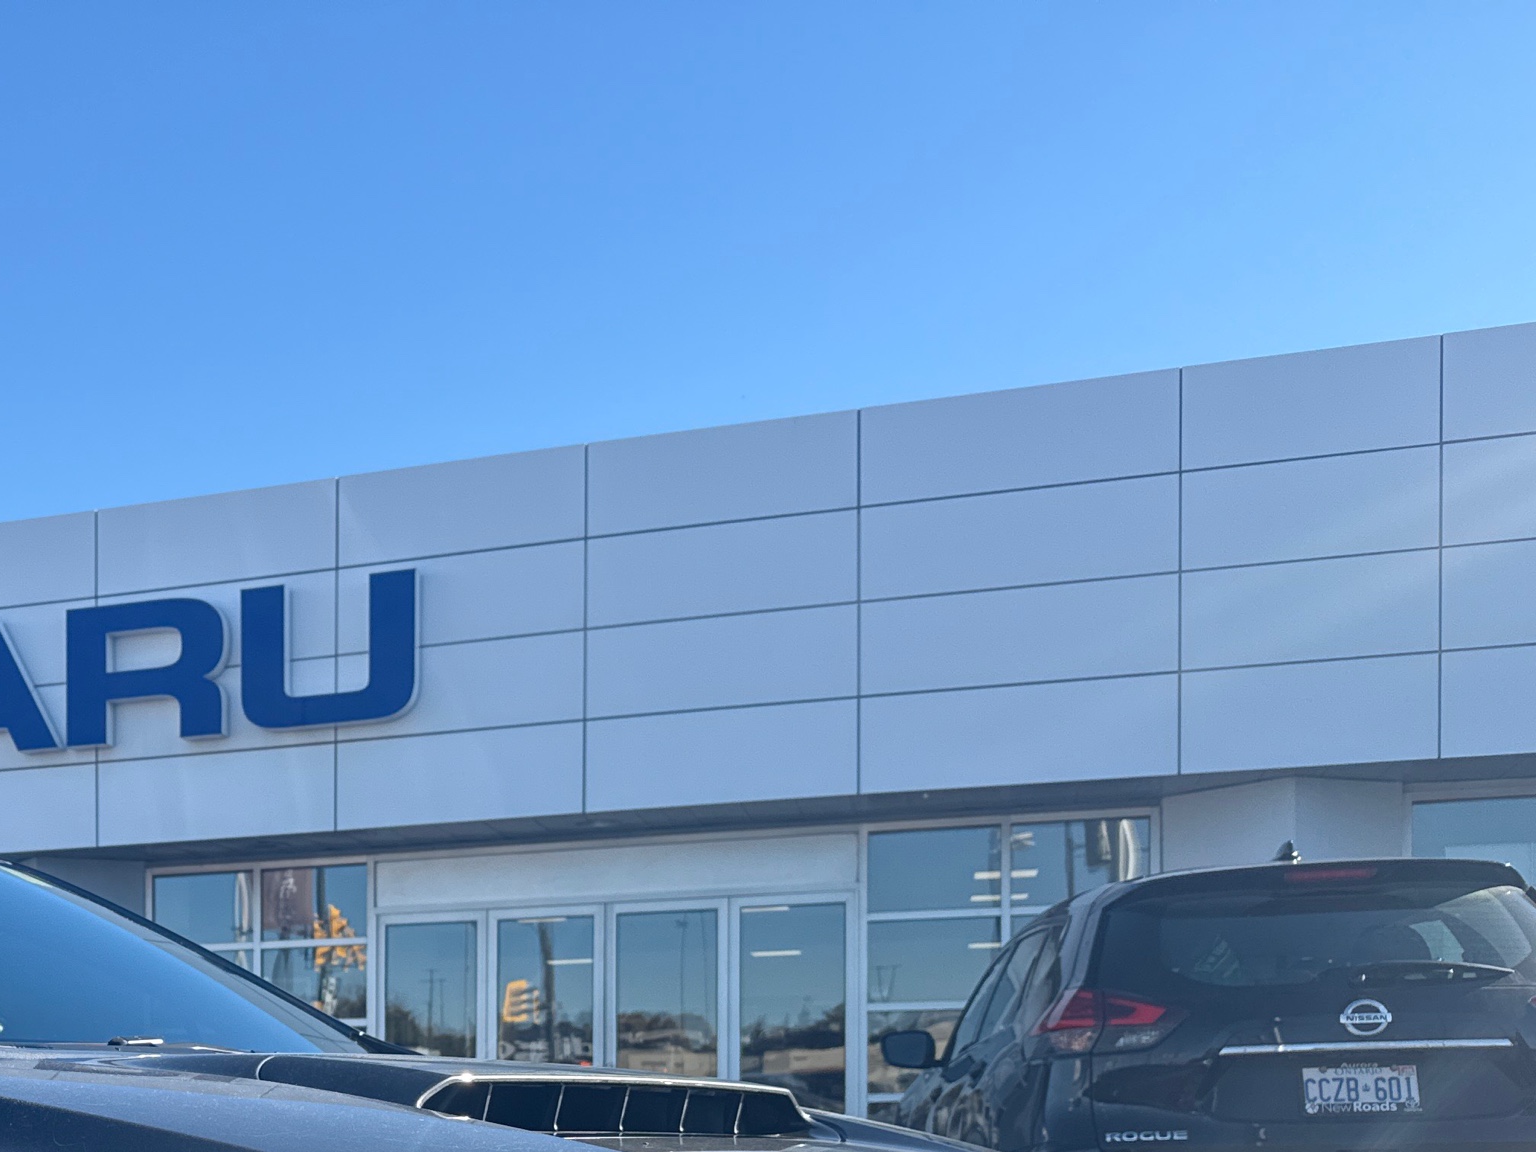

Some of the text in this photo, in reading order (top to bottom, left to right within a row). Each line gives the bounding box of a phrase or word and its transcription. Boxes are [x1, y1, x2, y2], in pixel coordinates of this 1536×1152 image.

[1305, 1077, 1414, 1102] CCZB 601
[1353, 1101, 1398, 1112] Roads
[1105, 1130, 1188, 1142] ROGUE
